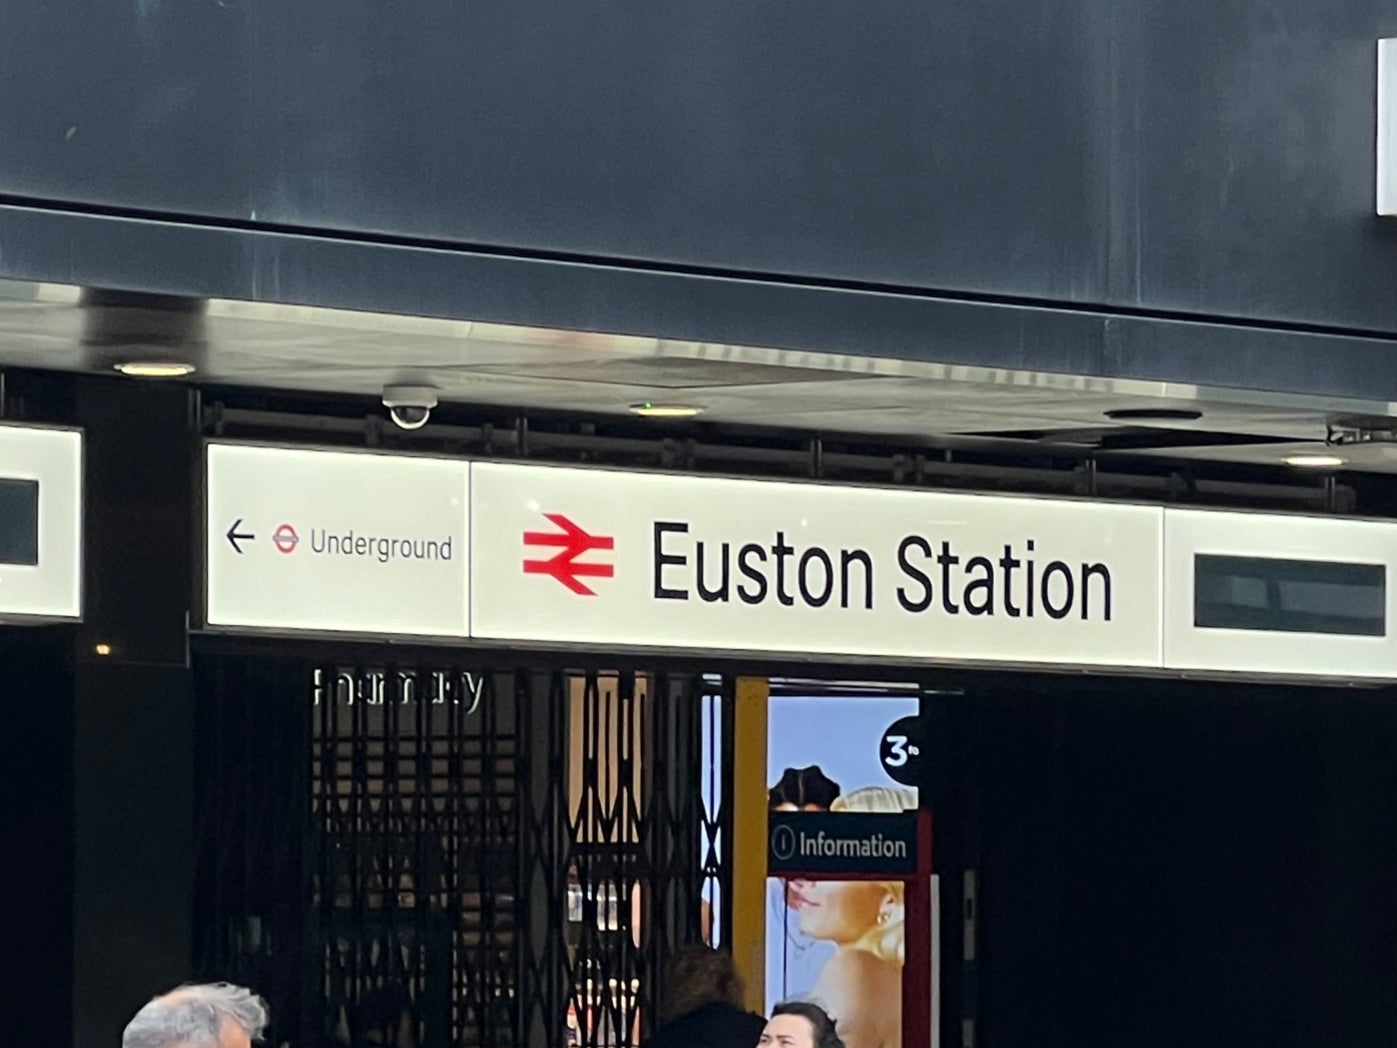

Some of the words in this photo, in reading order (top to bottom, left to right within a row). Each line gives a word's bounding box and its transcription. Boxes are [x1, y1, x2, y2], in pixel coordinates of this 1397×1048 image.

[310, 528, 452, 563] Underground
[652, 520, 874, 610] Euston
[895, 534, 1111, 622] Station
[799, 831, 907, 858] Information
